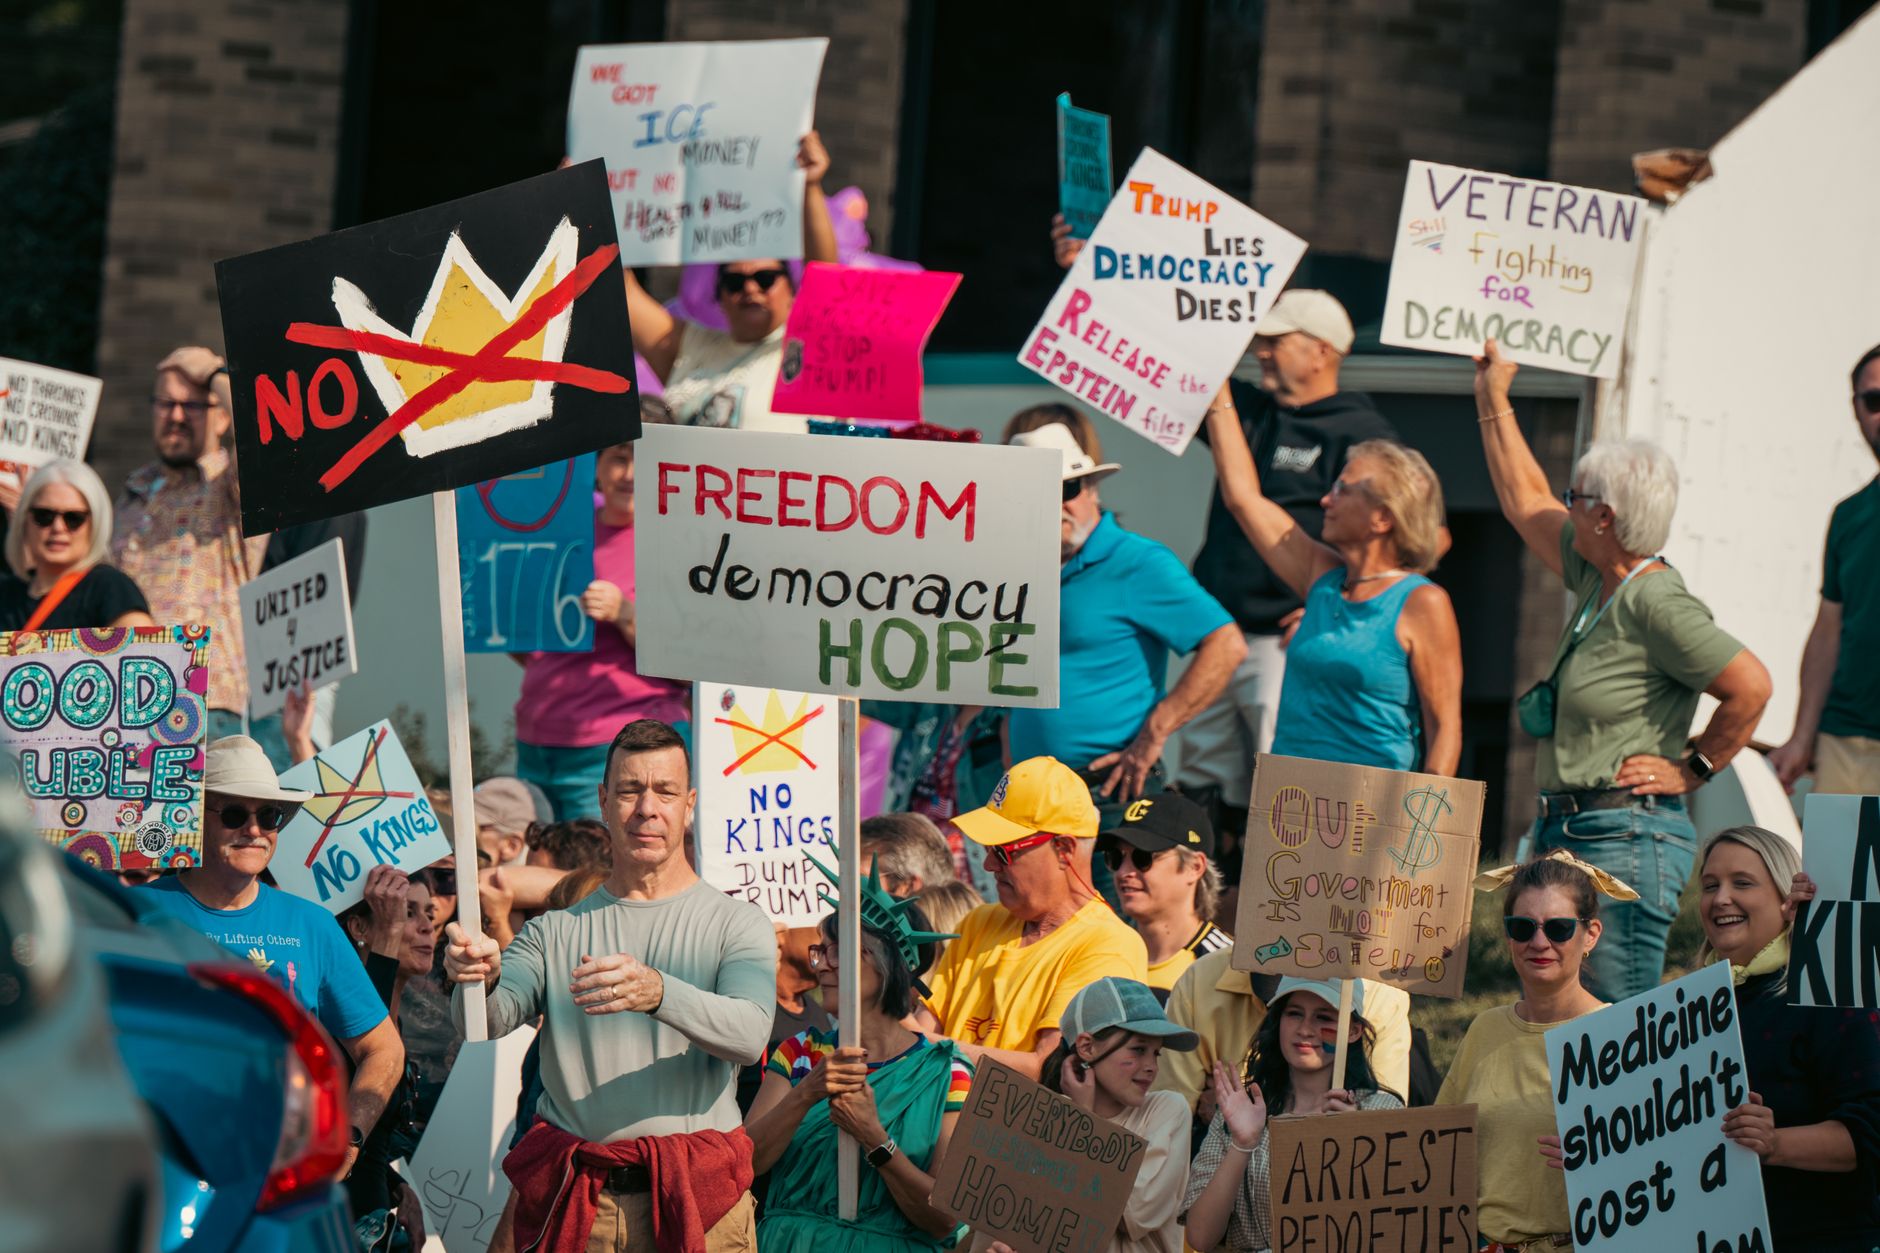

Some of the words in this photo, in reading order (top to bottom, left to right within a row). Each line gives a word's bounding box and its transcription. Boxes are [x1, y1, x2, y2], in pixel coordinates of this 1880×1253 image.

[591, 63, 624, 84] WE
[612, 84, 658, 105] GOT
[633, 102, 716, 148] ICE
[679, 136, 760, 169] MONEY
[653, 174, 676, 194] NO
[1129, 181, 1220, 223] TRUMP
[1427, 168, 1637, 242] VETERAN
[1093, 245, 1273, 287] DEMOCRACY
[1204, 228, 1264, 258] LIES
[1175, 287, 1257, 322] DIES!
[815, 334, 873, 363] STOP
[1057, 288, 1171, 389] RELEASE
[1179, 372, 1209, 394] the
[1404, 300, 1612, 374] DEMOCRACY
[7, 374, 28, 394] NO
[254, 357, 359, 445] NO
[1023, 326, 1137, 420] EPSTEIN
[1141, 406, 1186, 439] files
[5, 397, 26, 415] NO
[2, 420, 28, 446] NO
[32, 425, 77, 459] KINGS
[658, 462, 977, 543] FREEDOM
[255, 571, 328, 626] UNITED
[478, 538, 587, 650] 1776
[688, 533, 1029, 657] democracy
[286, 618, 298, 646] 4
[262, 637, 345, 694] JUSTICE
[818, 617, 1039, 697] HOPE
[750, 783, 792, 814] NO
[310, 844, 361, 902] NO
[359, 798, 438, 865] KINGS
[725, 816, 834, 853] KINGS
[734, 857, 817, 886] DUMP
[1266, 850, 1449, 910] Government
[224, 933, 264, 946] Lifting
[266, 934, 301, 947] Others
[1329, 904, 1395, 937] NOT
[1414, 912, 1448, 943] for
[1557, 986, 1733, 1104] Medicine
[973, 1066, 1143, 1173] EVERYBODY
[1563, 1050, 1744, 1171] shouldn't
[1282, 1127, 1473, 1204] ARREST
[1575, 1160, 1676, 1246] cost
[1700, 1142, 1727, 1193] a
